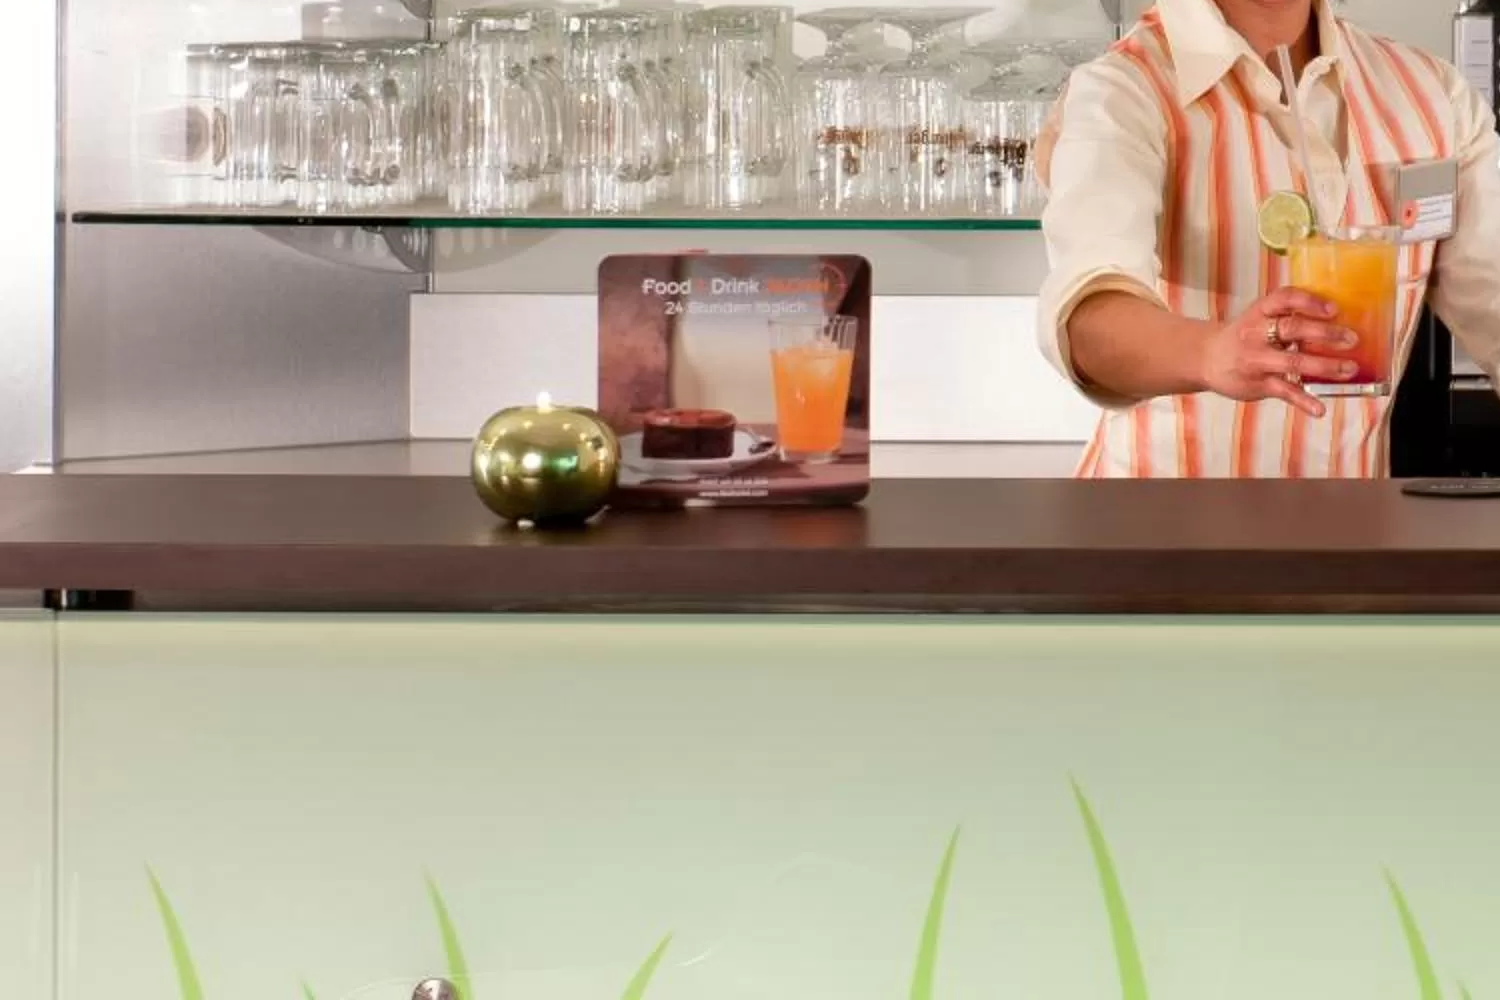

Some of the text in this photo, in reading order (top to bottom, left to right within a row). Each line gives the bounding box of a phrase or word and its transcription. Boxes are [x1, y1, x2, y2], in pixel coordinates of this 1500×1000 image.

[641, 278, 692, 295] Food
[711, 277, 761, 294] Drink
[664, 301, 683, 315] 24
